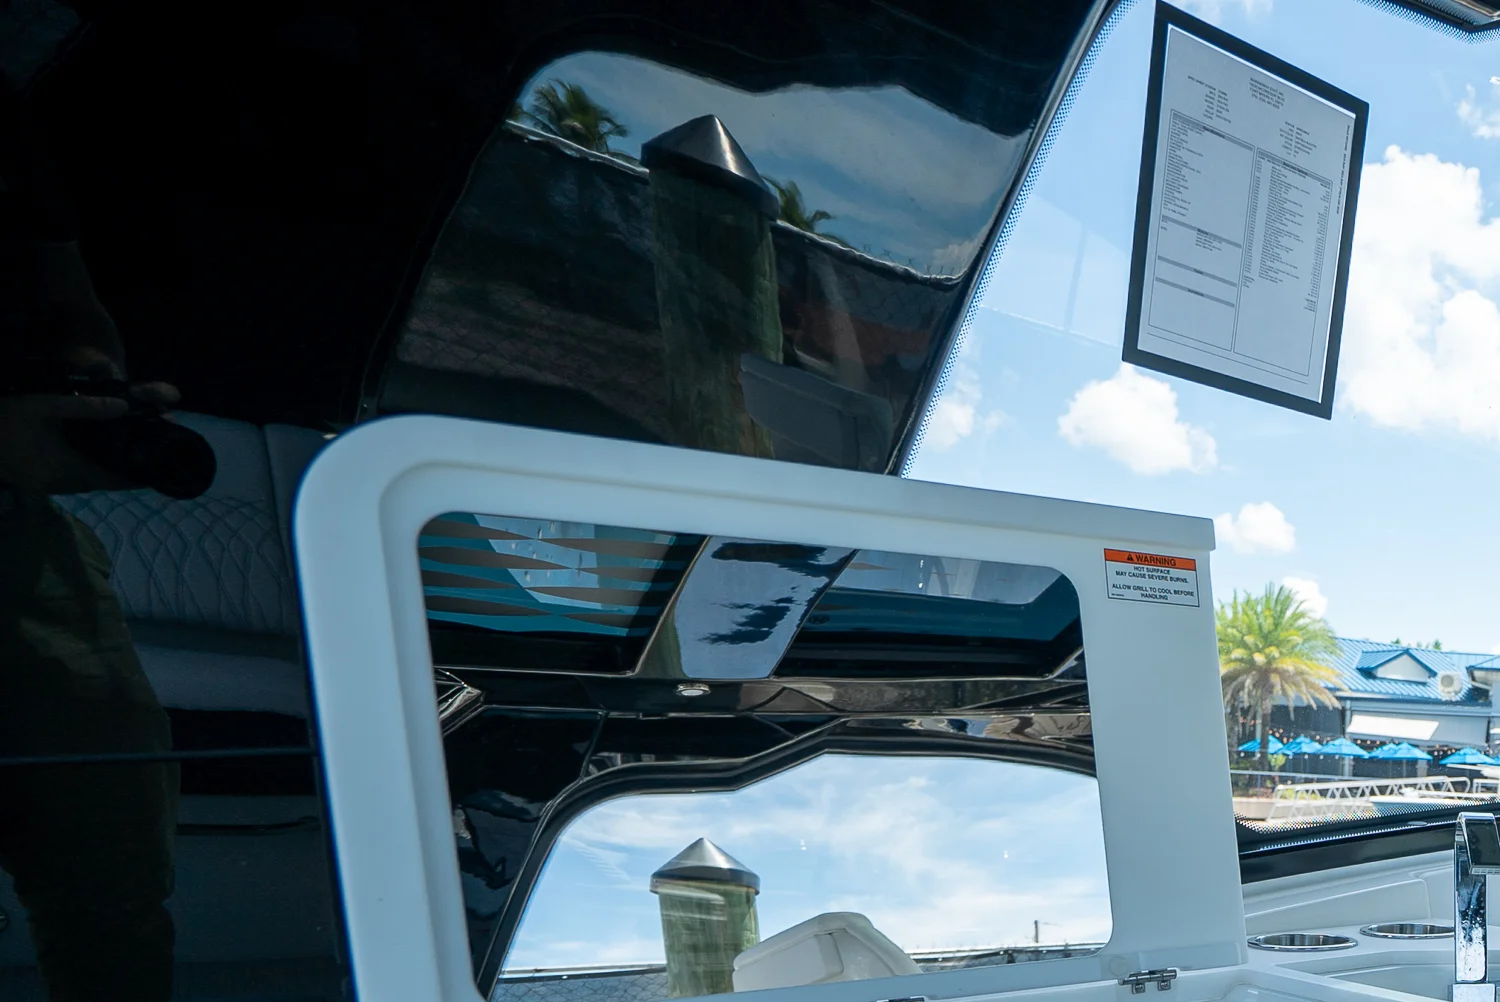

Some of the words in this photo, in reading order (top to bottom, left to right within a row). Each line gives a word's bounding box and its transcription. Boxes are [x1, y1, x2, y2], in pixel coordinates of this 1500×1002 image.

[1136, 554, 1176, 566] WARNING
[1146, 567, 1170, 575] SURFACE
[1141, 592, 1168, 600] HANDLING
[1174, 589, 1194, 597] BEFORE
